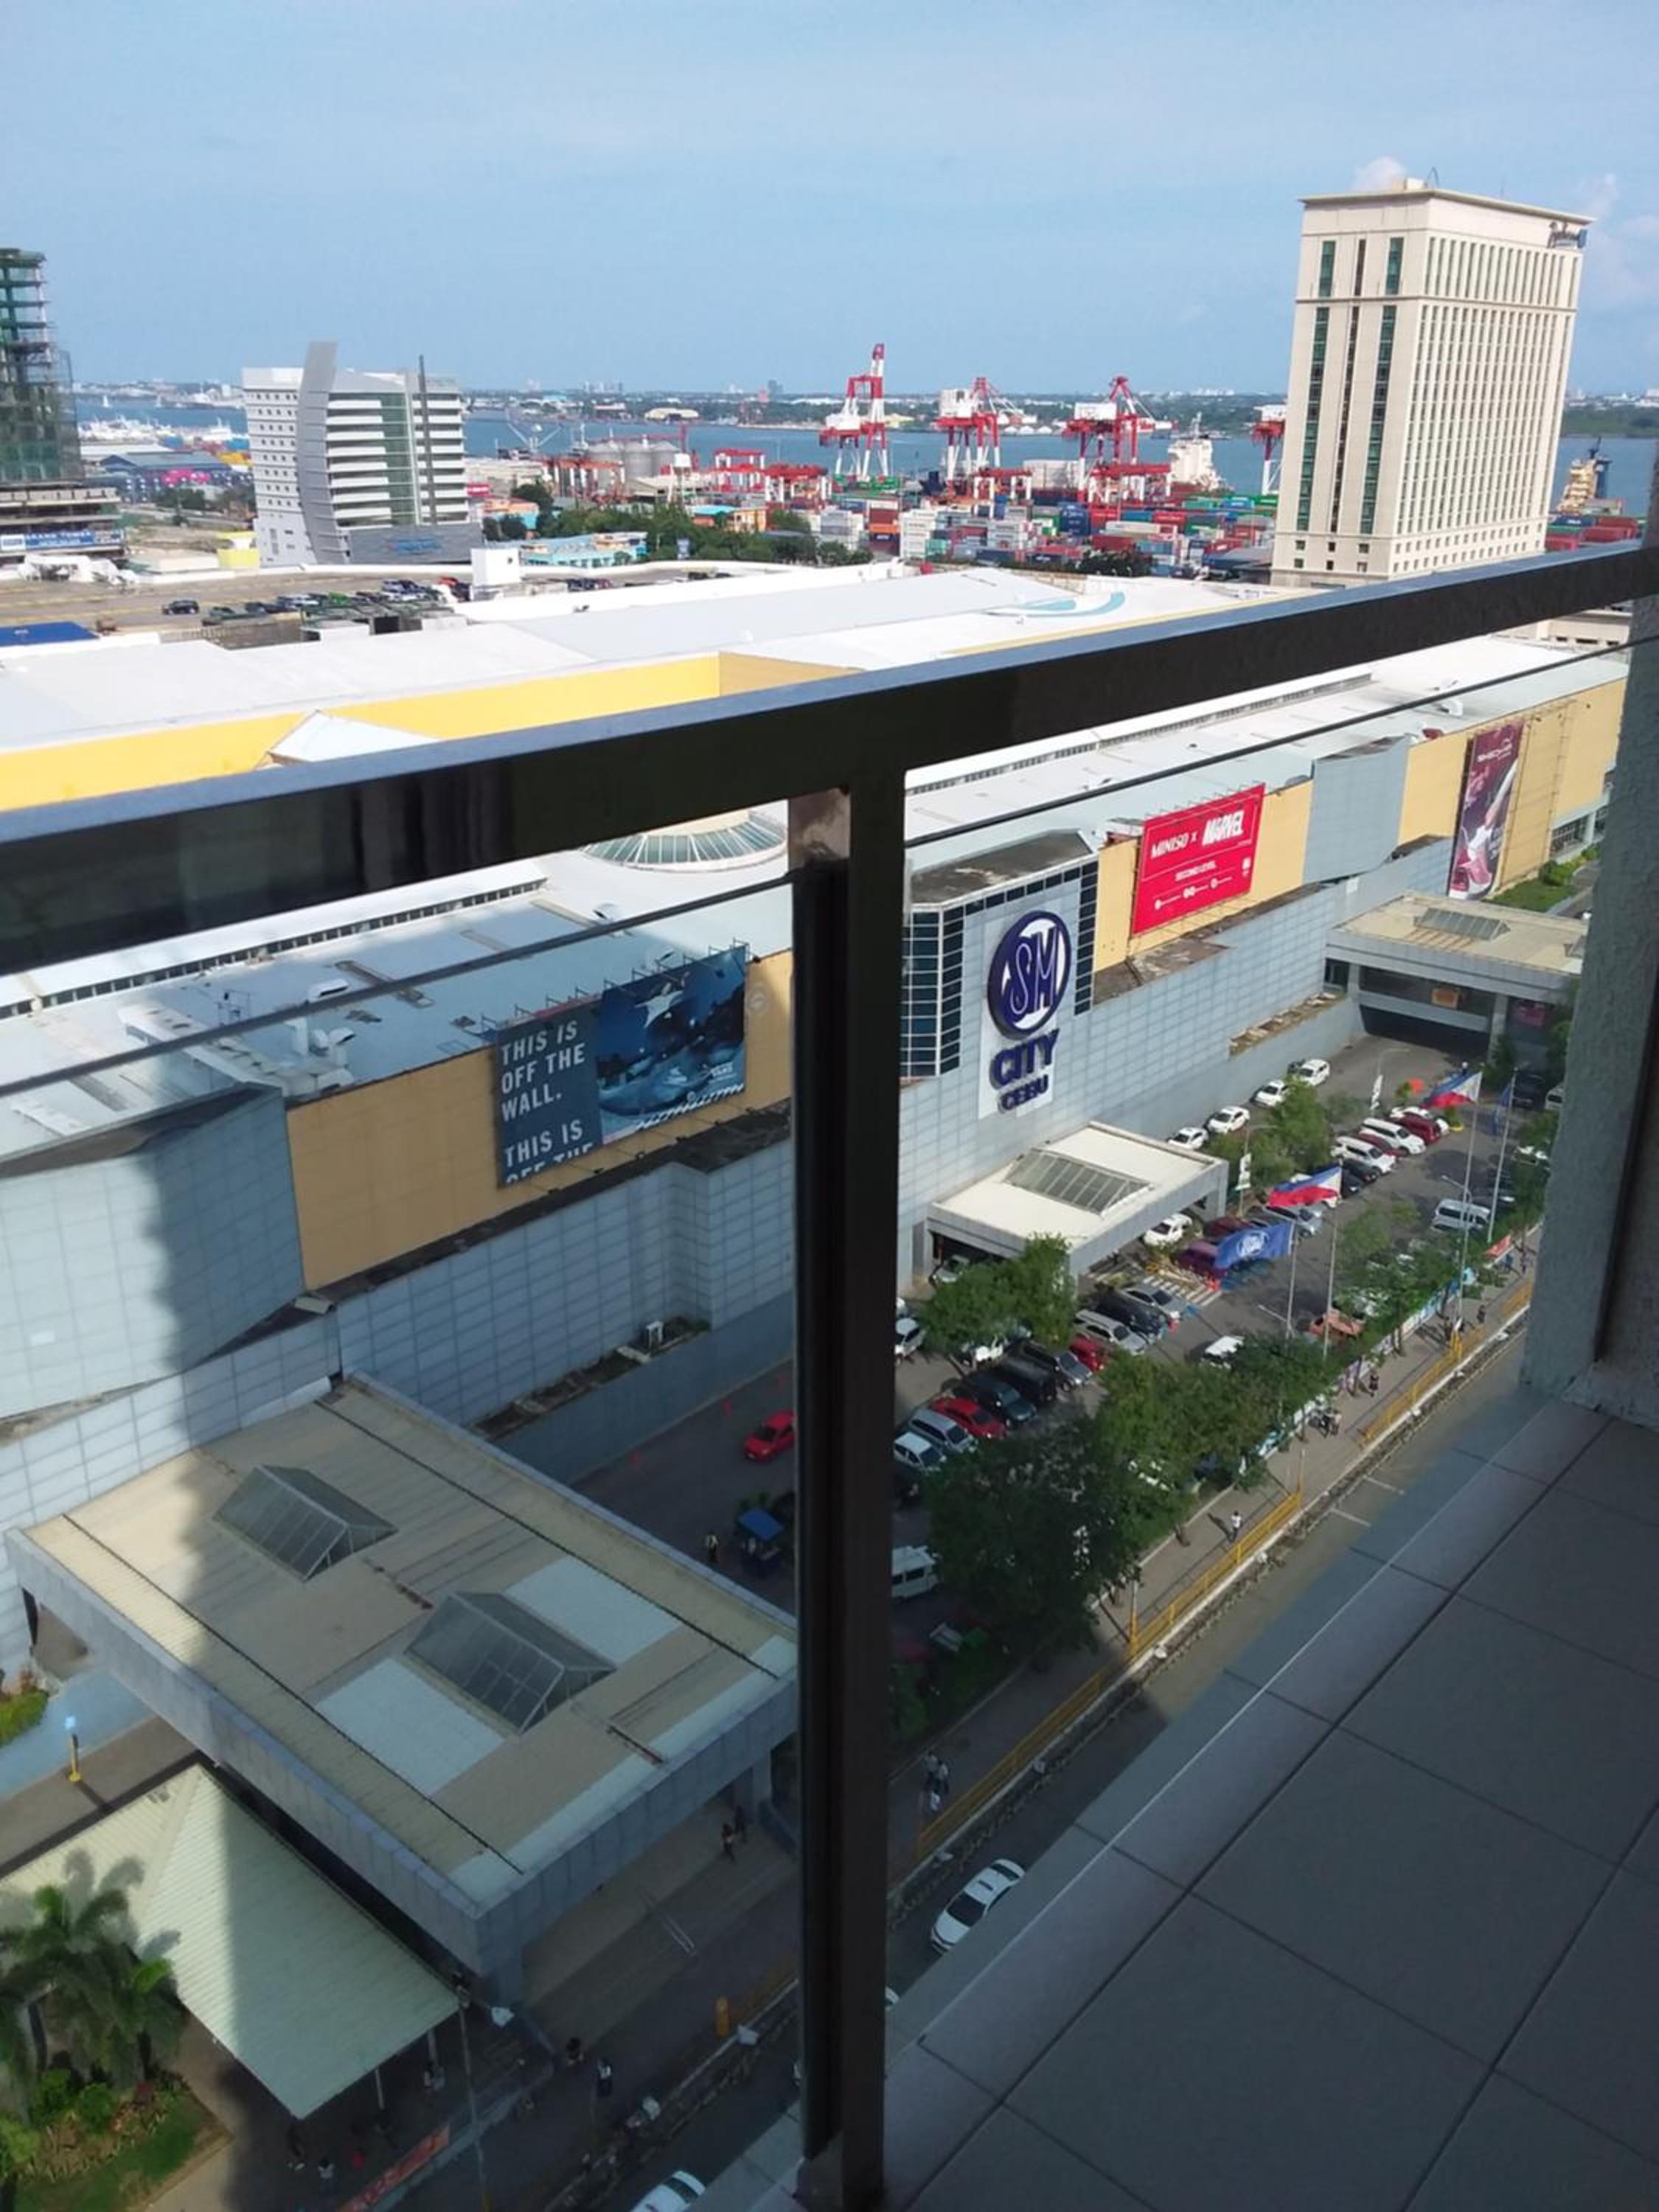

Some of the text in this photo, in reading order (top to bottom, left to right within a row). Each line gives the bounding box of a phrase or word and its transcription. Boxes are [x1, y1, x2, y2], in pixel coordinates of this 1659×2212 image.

[1150, 832, 1189, 859] MINISO
[1201, 810, 1245, 846] MARVEL
[1005, 926, 1060, 1019] SM
[501, 1020, 578, 1066] THIS IS
[992, 1029, 1060, 1089] CITY
[501, 1043, 586, 1094] OFF THE
[501, 1083, 562, 1122] WALL.
[1001, 1074, 1049, 1112] CEBU
[504, 1130, 553, 1167] THIS
[561, 1119, 584, 1142] IS
